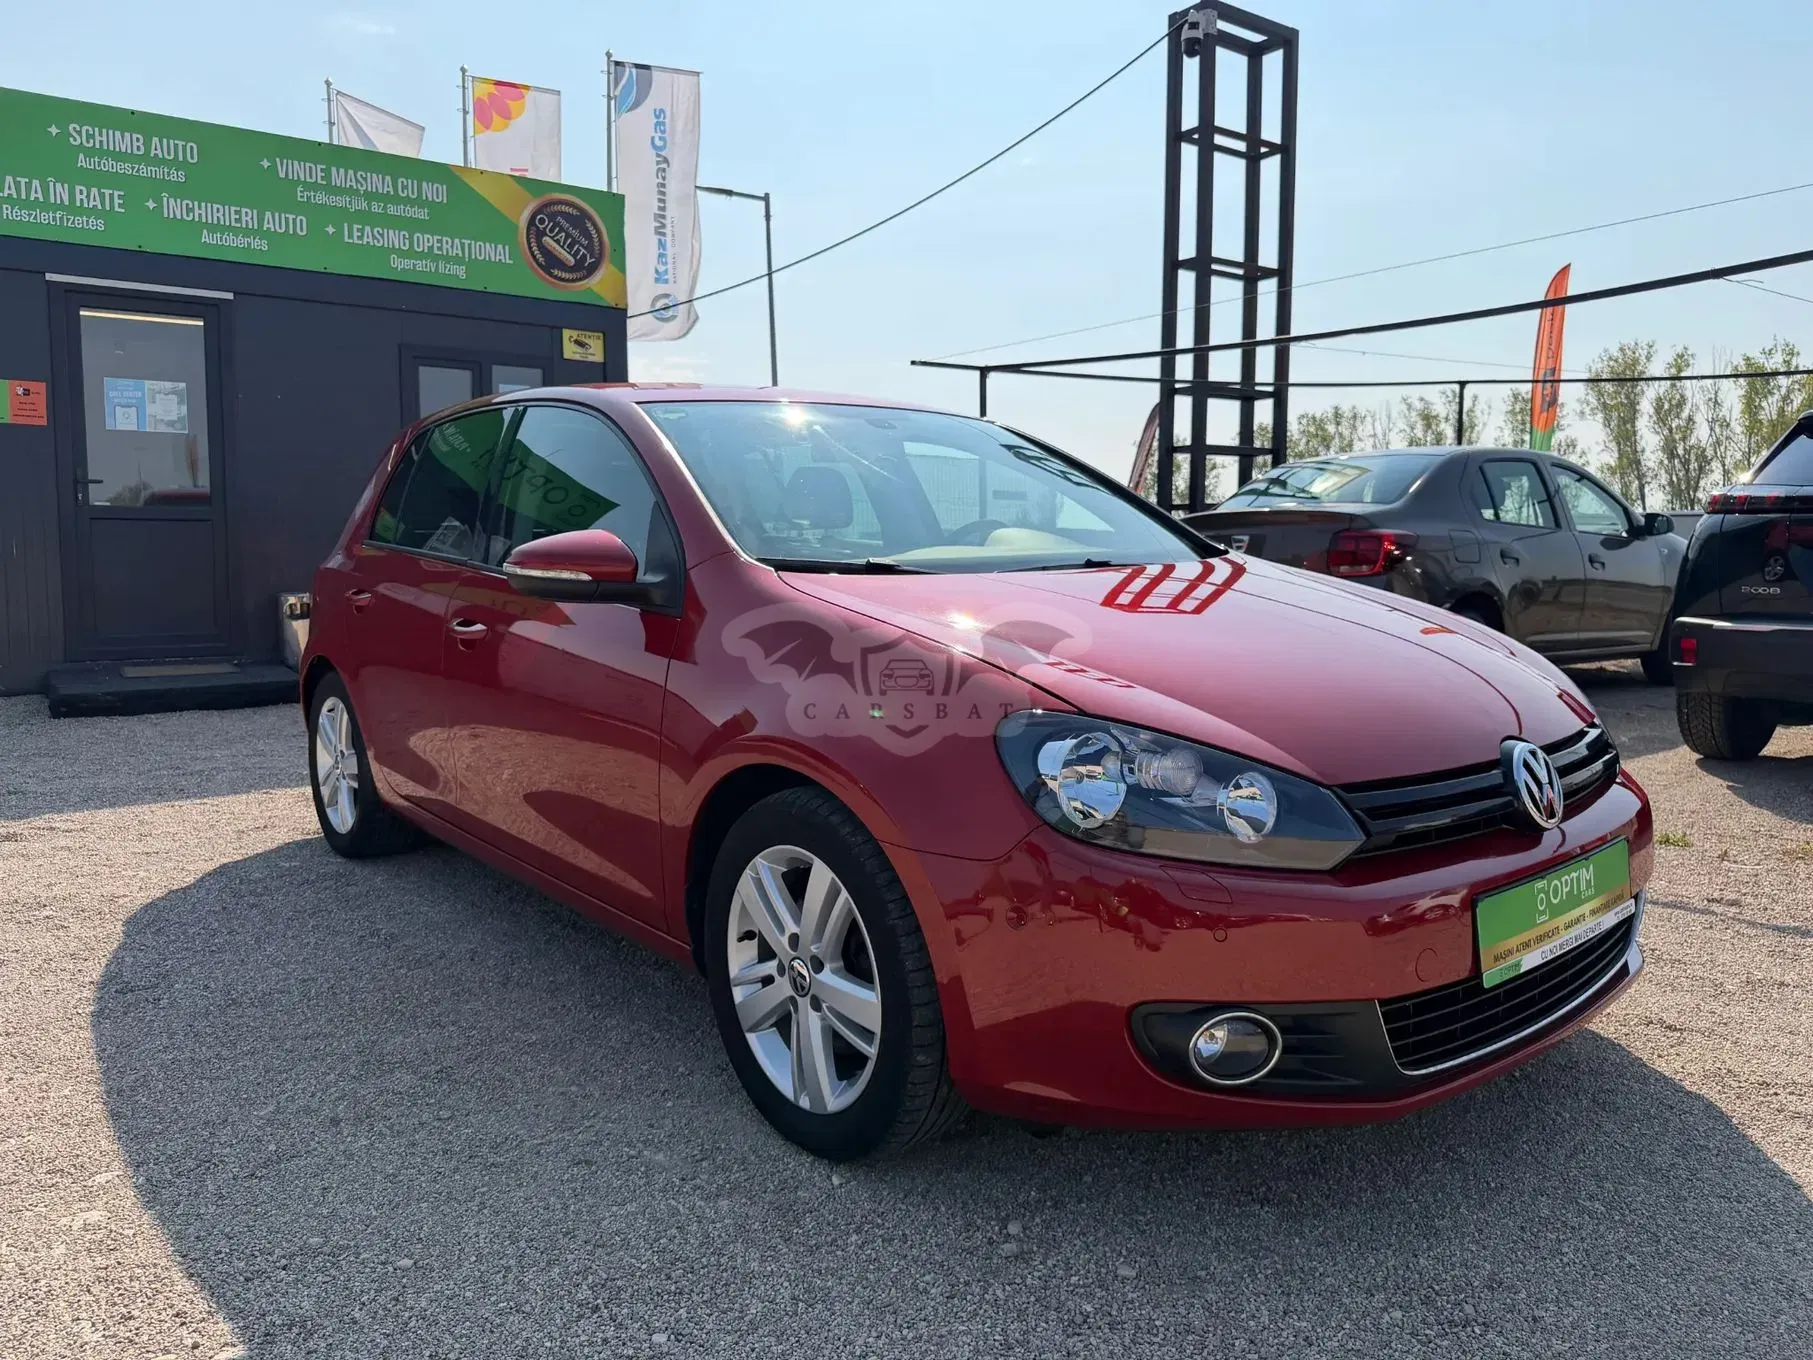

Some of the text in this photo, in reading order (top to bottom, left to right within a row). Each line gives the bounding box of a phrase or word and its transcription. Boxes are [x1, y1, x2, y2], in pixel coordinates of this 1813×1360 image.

[68, 123, 198, 164] SCHIMB AUTO
[77, 152, 186, 183] Autóbeszámítás
[276, 157, 448, 204] VINDE MAȘINA CU NOI
[0, 175, 126, 213] ATA ÎN RATE
[161, 192, 308, 236] ÎNCHIRIERI AUTO
[296, 185, 430, 220] Értékesítjük az autódat
[650, 107, 670, 285] KazMunayGas
[2, 203, 105, 231] Részletfizetés
[201, 228, 268, 251] Autóbérlés
[343, 222, 409, 251] LEASING
[413, 233, 514, 264] OPERAȚIONAL
[535, 214, 597, 267] QUALITY
[1550, 863, 1595, 904] OPTIM
